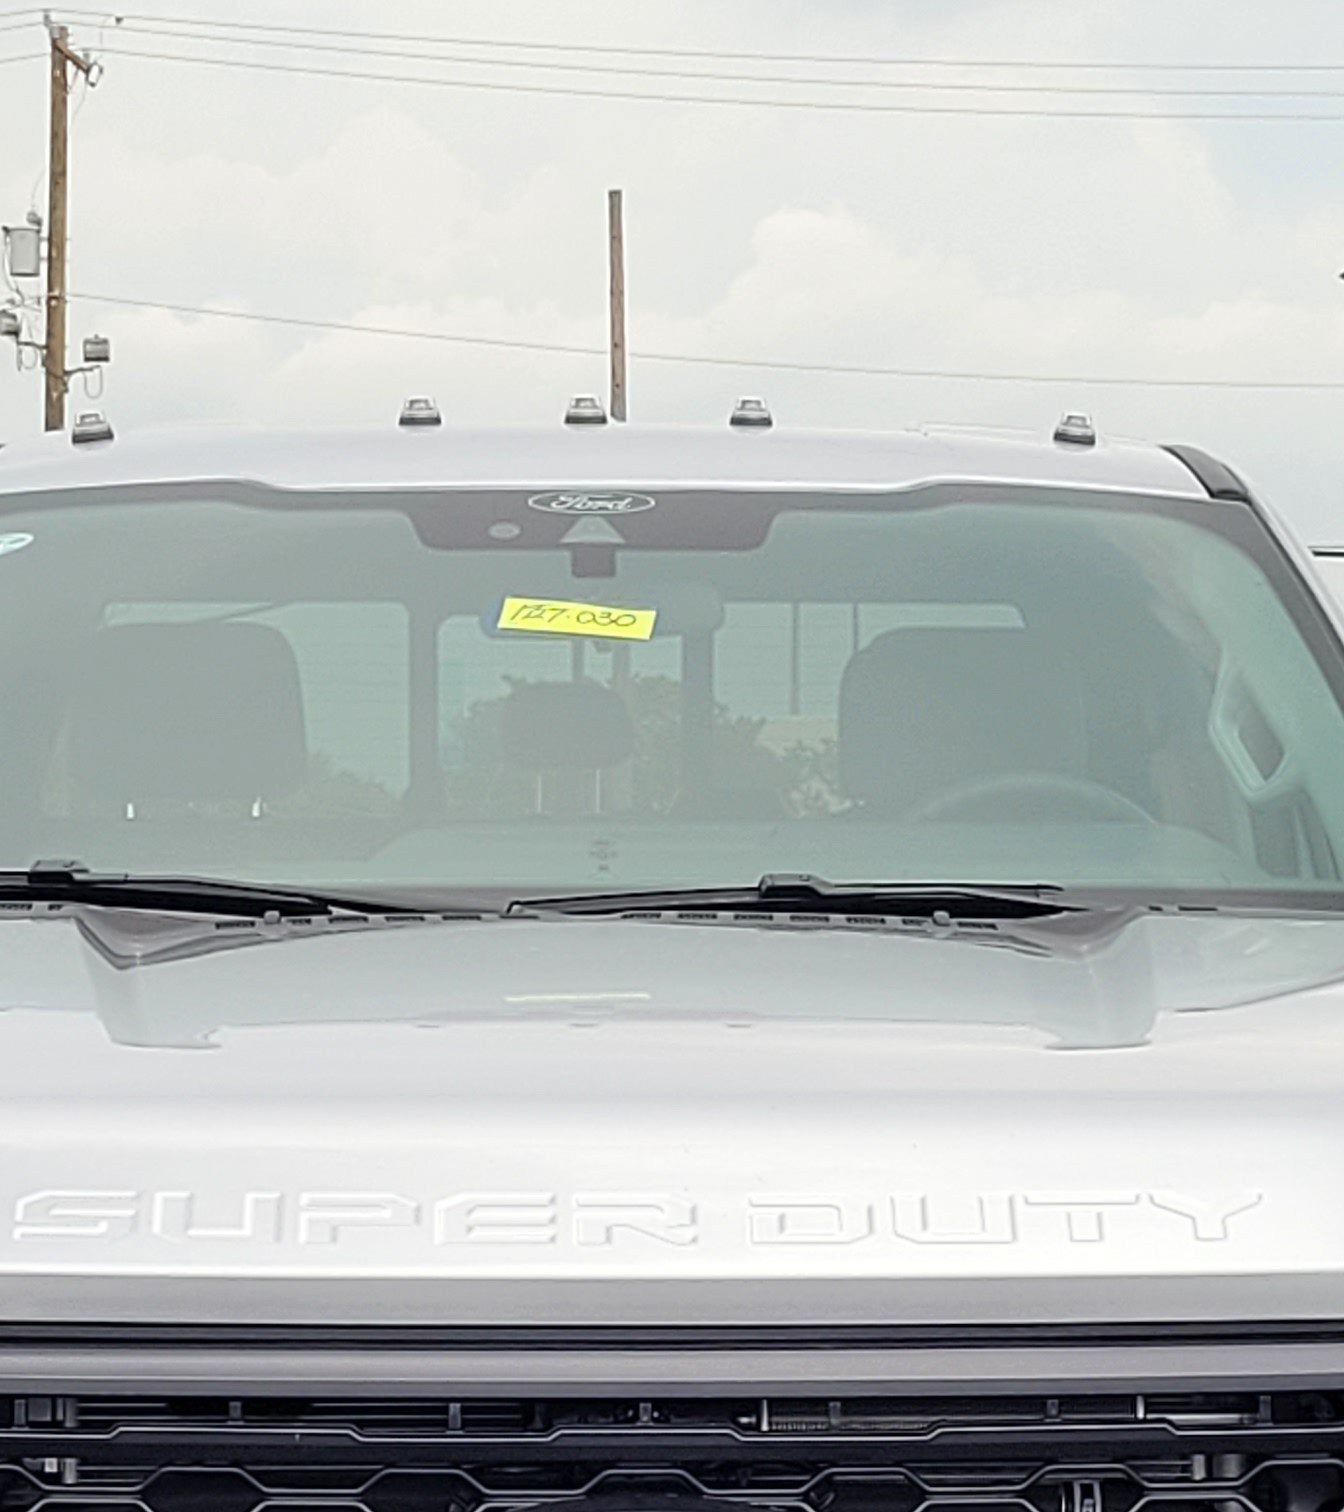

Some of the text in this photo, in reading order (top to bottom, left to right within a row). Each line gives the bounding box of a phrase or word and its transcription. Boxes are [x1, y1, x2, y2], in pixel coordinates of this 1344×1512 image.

[550, 492, 633, 511] Ford
[11, 1189, 1264, 1246] SUPER DUTY
